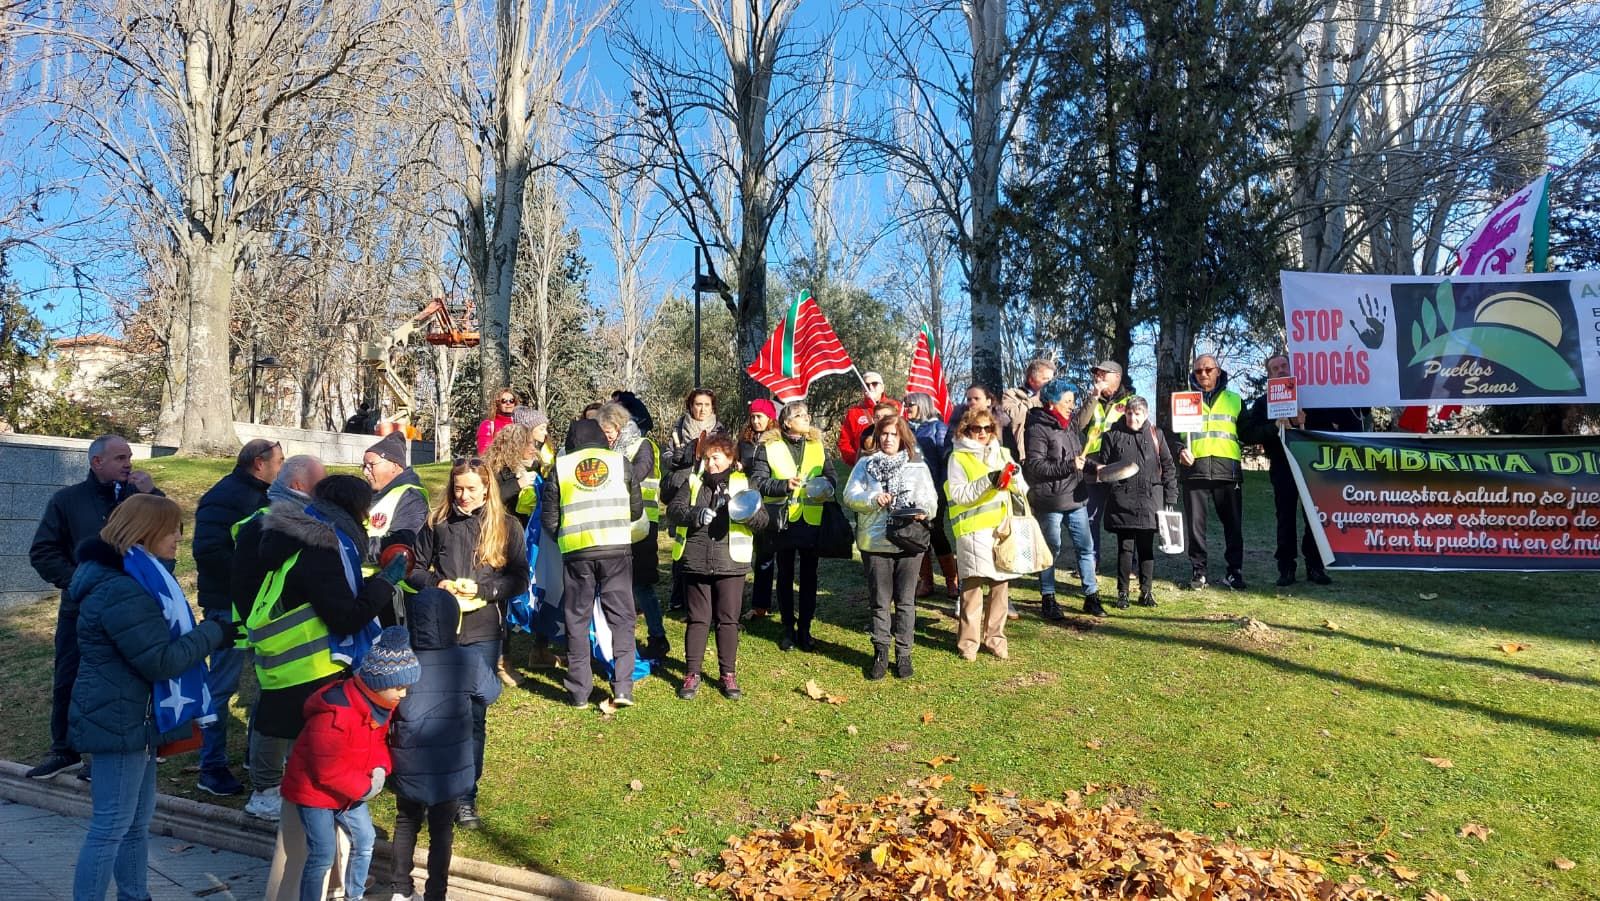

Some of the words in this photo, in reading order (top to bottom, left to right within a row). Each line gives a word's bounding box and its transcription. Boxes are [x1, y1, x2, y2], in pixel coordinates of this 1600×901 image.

[1291, 309, 1343, 342] STOP
[1293, 345, 1370, 386] BIOGÁS
[1423, 360, 1494, 378] Pueblos
[1462, 377, 1519, 394] Sanos
[1312, 446, 1536, 474] JAMBRINA
[1549, 450, 1600, 475] DI
[1342, 484, 1378, 501] Con
[1380, 484, 1451, 504] nuestra
[1452, 486, 1510, 504] salud
[1512, 491, 1536, 503] no
[1538, 491, 1566, 506] se
[1331, 511, 1420, 529] queremos
[1422, 512, 1453, 526] ser
[1457, 508, 1568, 527] estercolero
[1573, 510, 1600, 527] de
[1364, 528, 1386, 546] Ni
[1388, 535, 1411, 546] en
[1413, 530, 1433, 547] tu
[1436, 530, 1498, 552] pueblo
[1502, 532, 1521, 549] ni
[1523, 538, 1549, 550] en
[1551, 532, 1571, 550] el
